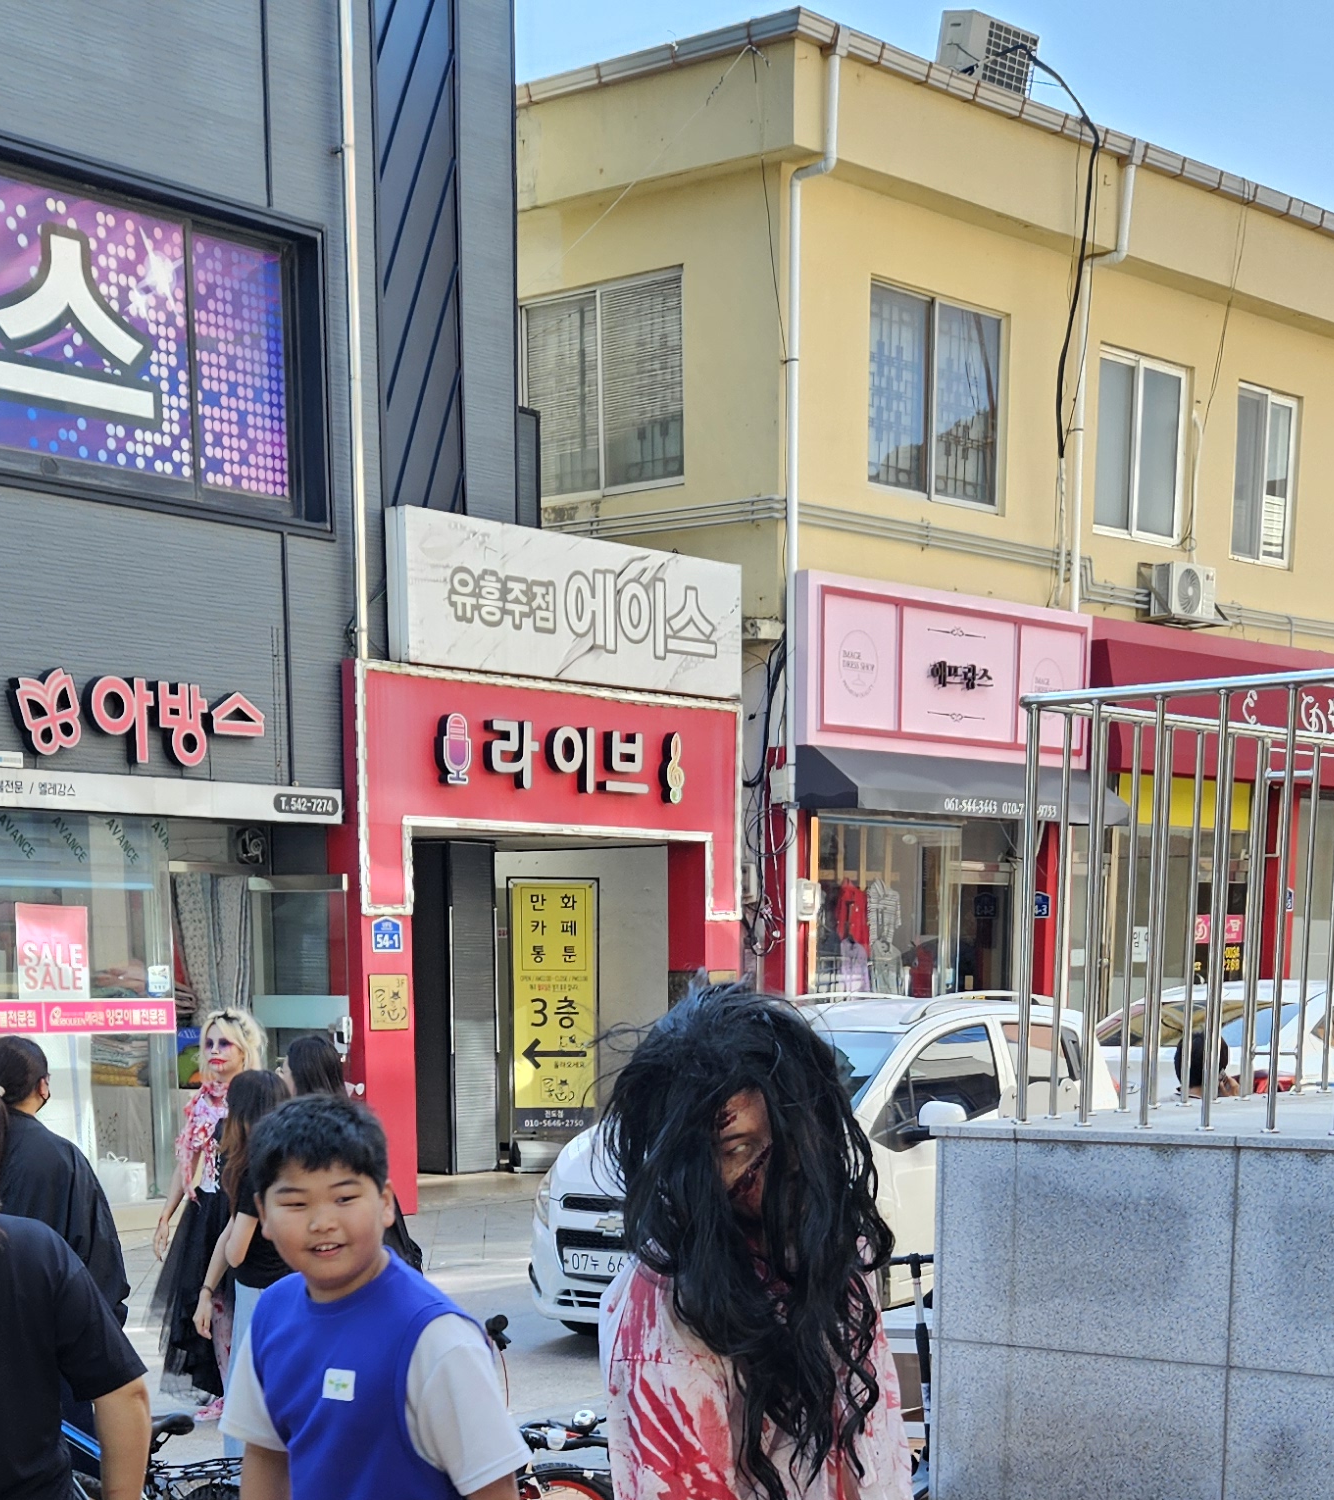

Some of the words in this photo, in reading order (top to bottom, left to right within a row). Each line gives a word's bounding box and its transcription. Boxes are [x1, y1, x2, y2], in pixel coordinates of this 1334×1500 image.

[448, 565, 558, 635] 유흥주점
[564, 565, 718, 660] 에이스
[89, 673, 266, 767] 아방스
[489, 716, 650, 796] 라이브
[944, 797, 998, 814] 061-544-3443
[51, 816, 88, 864] AVANCE
[105, 818, 140, 866] AVANCE
[22, 940, 83, 969] SALE
[375, 933, 400, 949] 54-1
[24, 965, 84, 991] SALE
[530, 995, 580, 1029] 3층
